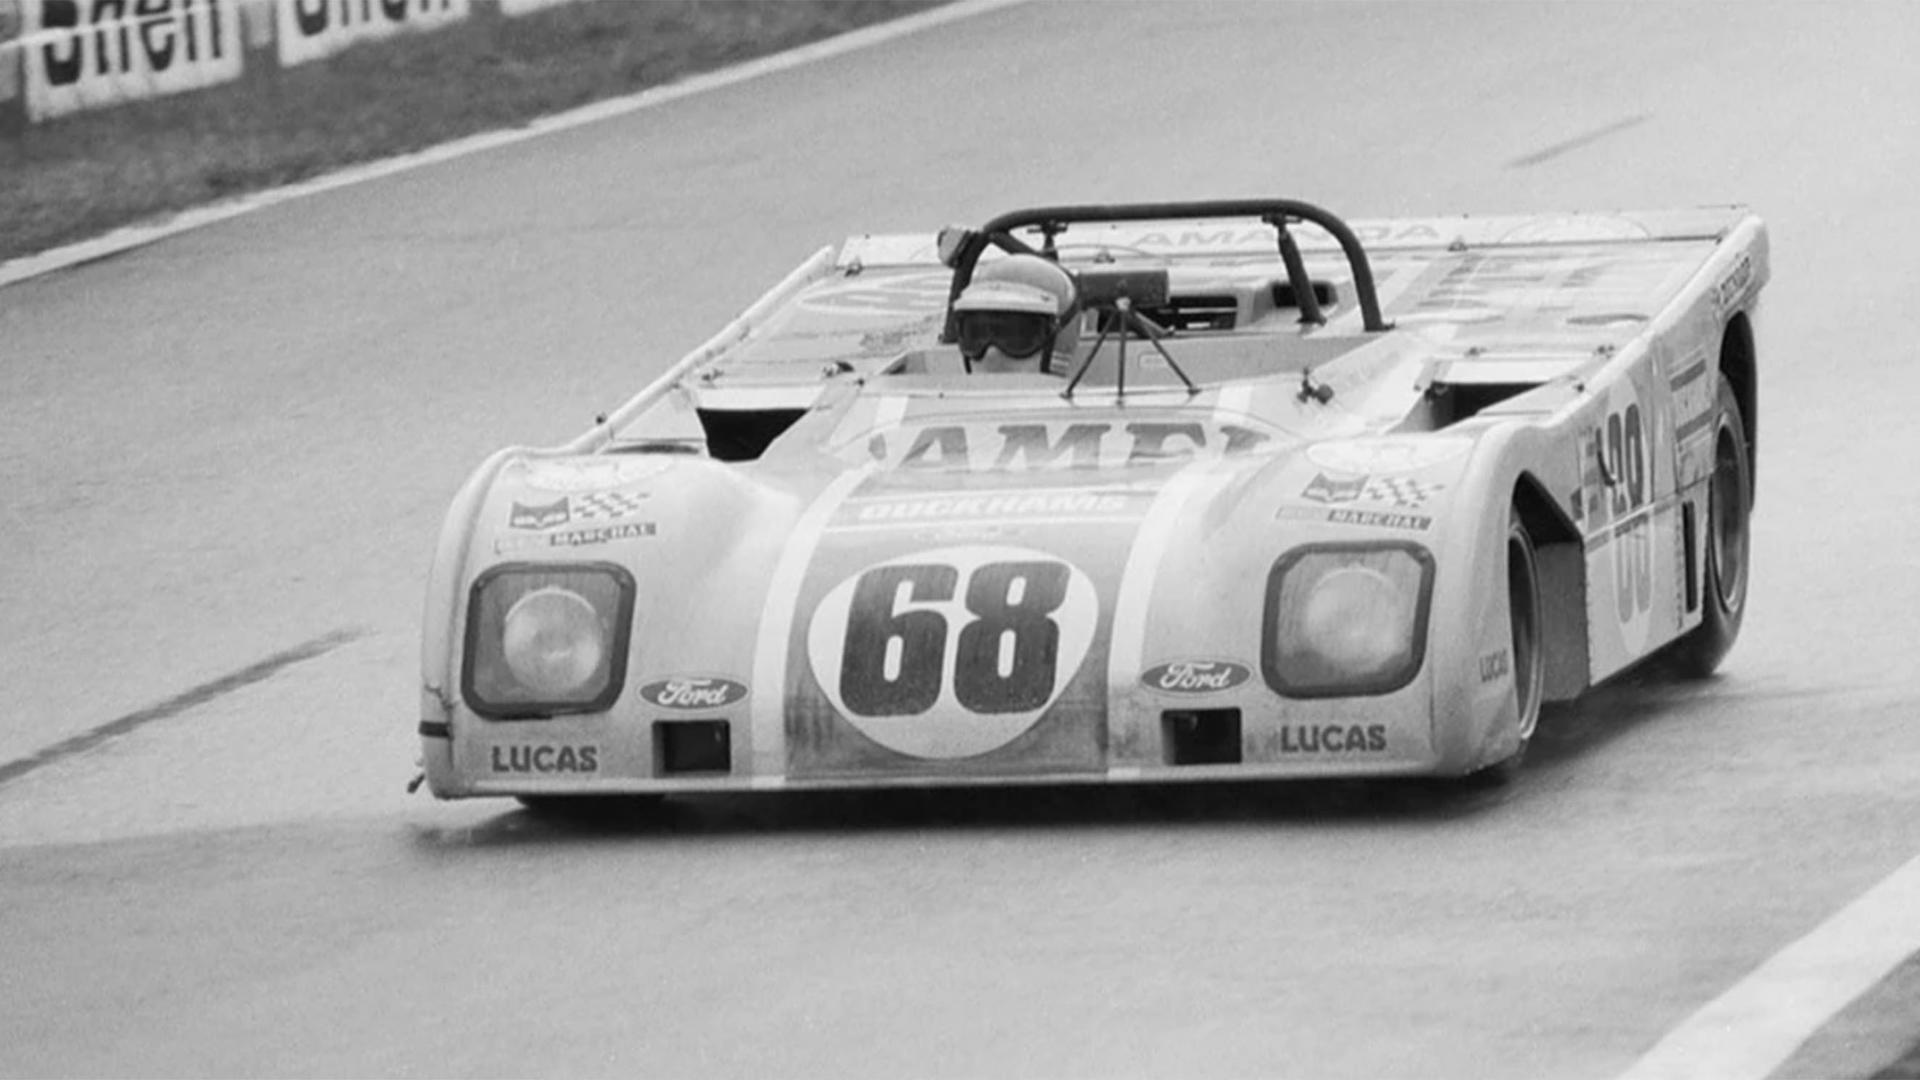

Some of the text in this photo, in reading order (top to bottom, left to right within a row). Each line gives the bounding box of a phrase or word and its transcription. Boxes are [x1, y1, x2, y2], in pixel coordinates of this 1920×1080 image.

[859, 496, 1126, 520] DUCKHAMS
[551, 524, 654, 545] MARCHAL
[839, 560, 1072, 717] 68
[1159, 661, 1231, 689] Ford
[657, 679, 730, 705] Ford
[1280, 724, 1387, 753] LUCAS
[491, 745, 598, 773] LUCAS
